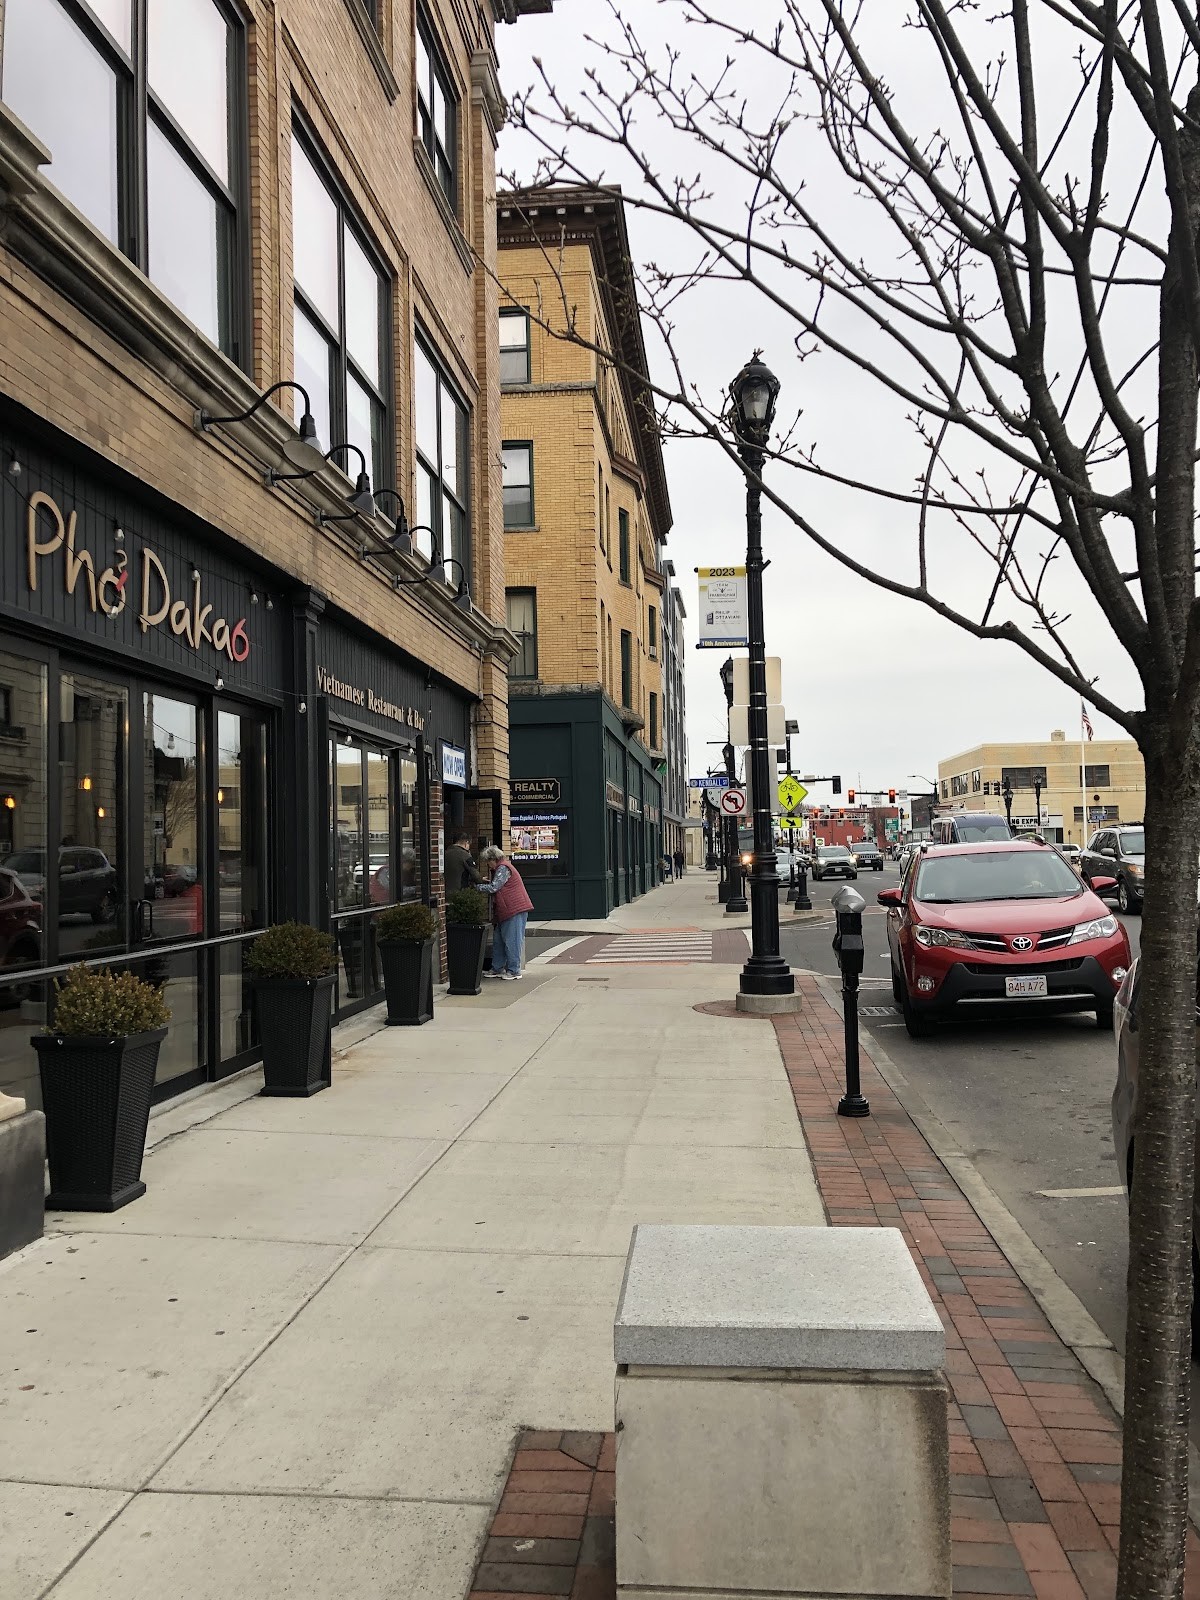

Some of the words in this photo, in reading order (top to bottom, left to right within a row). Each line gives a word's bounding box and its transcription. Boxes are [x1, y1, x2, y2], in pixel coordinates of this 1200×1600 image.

[709, 567, 736, 577] 2023
[317, 665, 365, 707] Vietnamese
[367, 688, 405, 723] Restaurant
[407, 707, 414, 727] &
[414, 709, 425, 731] Bar
[443, 752, 454, 776] NOW
[454, 756, 466, 778] OPEN
[514, 782, 555, 792] REALTY
[698, 779, 722, 787] KENDALL
[1008, 981, 1026, 993] 84H
[1028, 981, 1045, 992] A72
